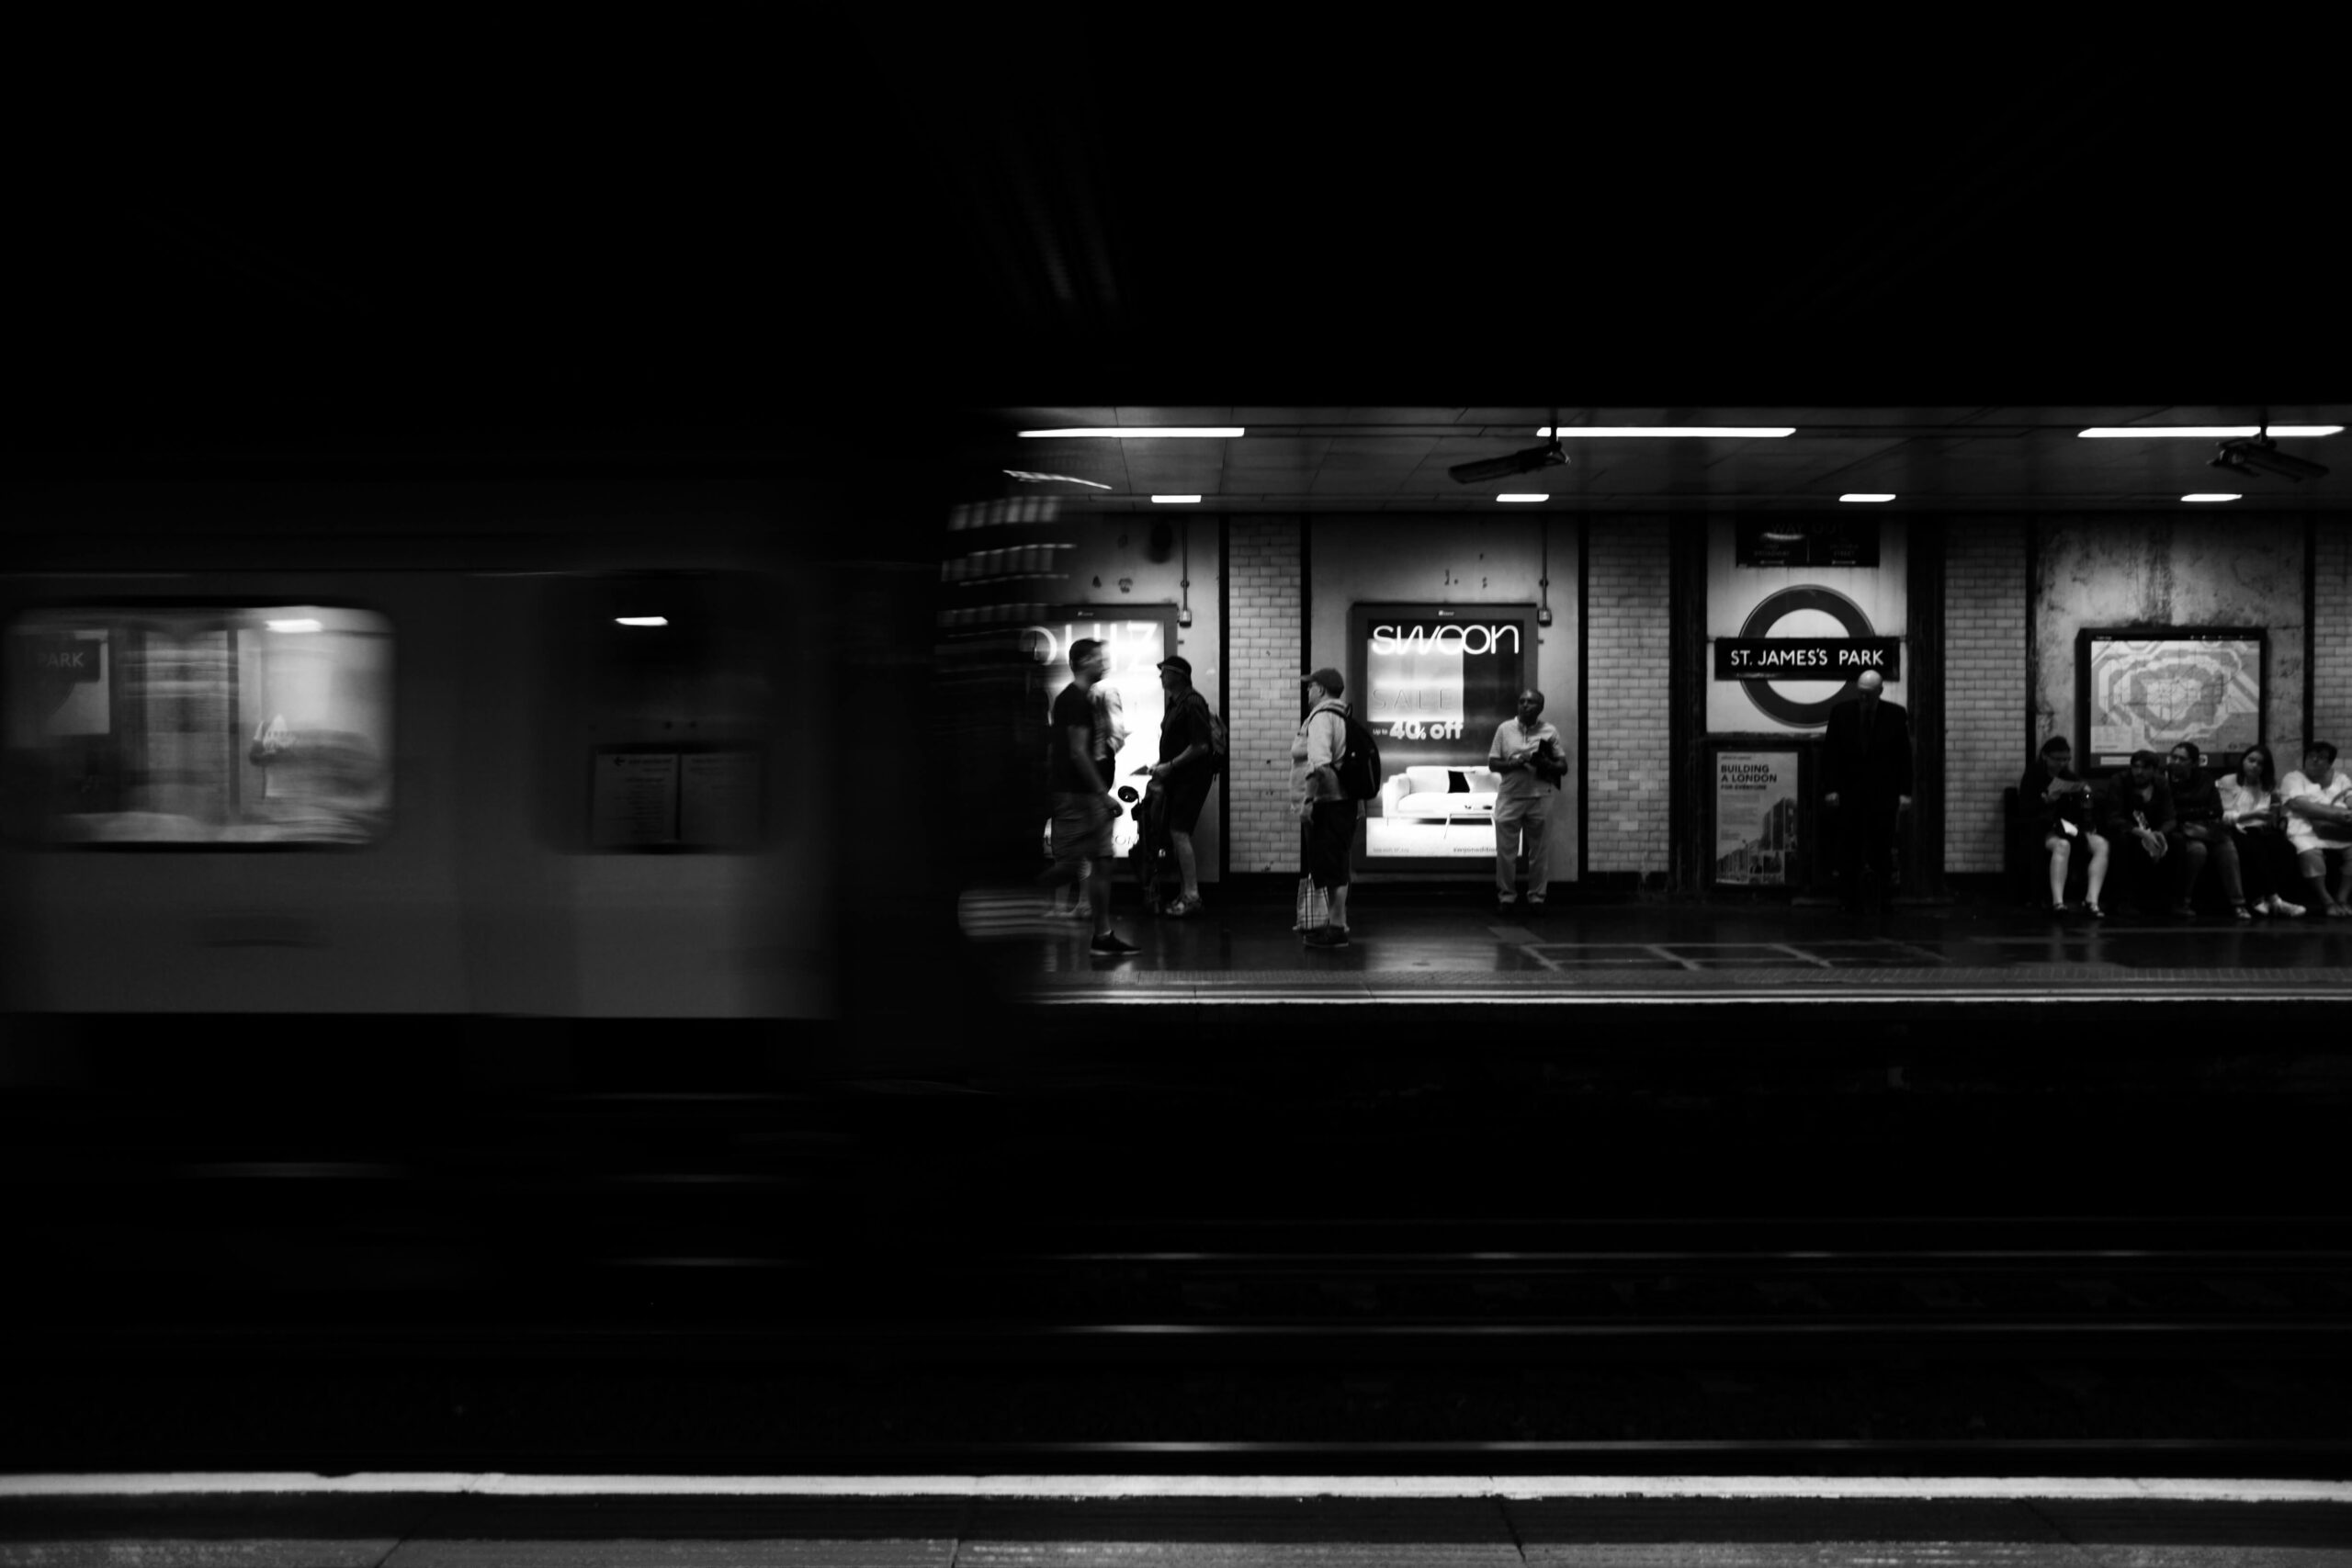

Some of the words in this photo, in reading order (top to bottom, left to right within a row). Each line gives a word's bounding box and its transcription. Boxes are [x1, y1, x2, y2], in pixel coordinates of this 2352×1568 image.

[37, 651, 85, 668] PARK
[1731, 649, 1753, 666] ST.
[1758, 648, 1828, 666] JAMES'S
[1838, 649, 1884, 666] PARK
[1373, 690, 1453, 710] SALE
[1389, 718, 1427, 740] 40%
[1430, 718, 1464, 740] off
[1721, 764, 1770, 773] BUILDING
[1721, 773, 1728, 783] A
[1732, 773, 1778, 784] LONDON
